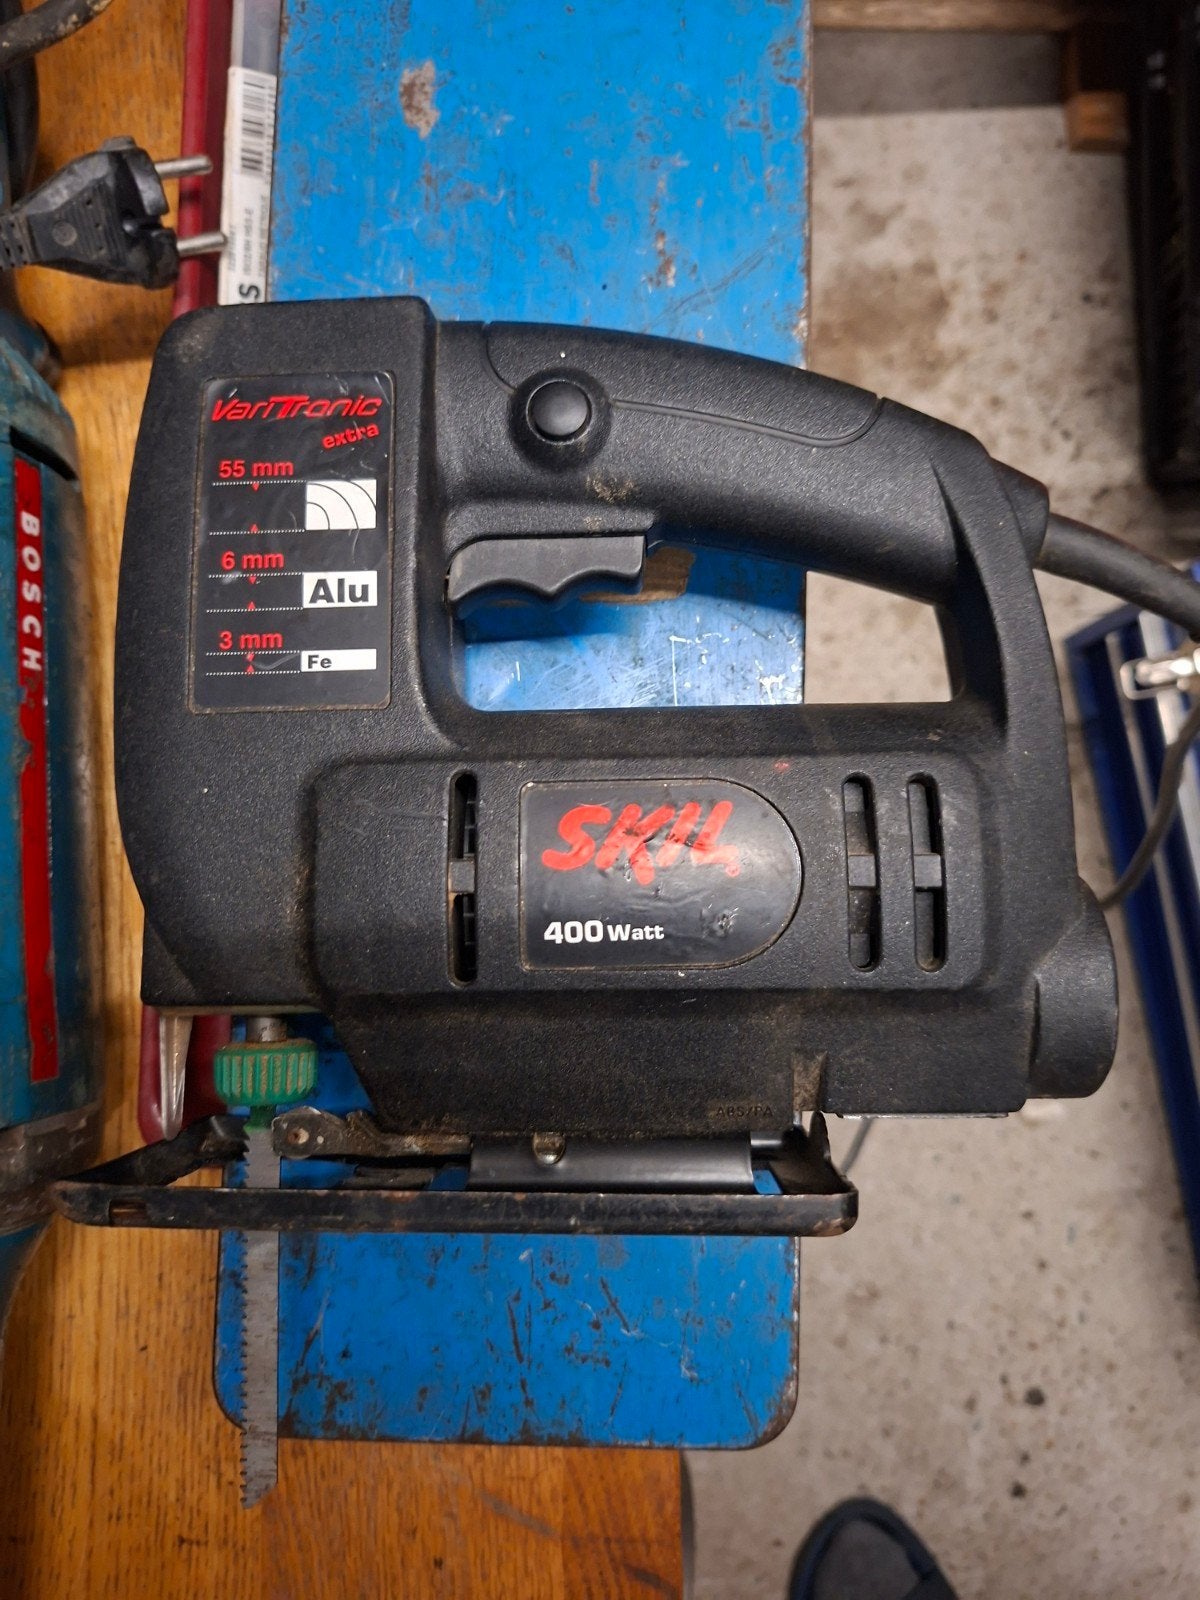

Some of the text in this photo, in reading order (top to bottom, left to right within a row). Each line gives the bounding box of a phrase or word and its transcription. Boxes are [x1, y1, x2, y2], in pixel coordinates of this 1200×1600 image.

[211, 394, 383, 422] VariTronic
[322, 422, 380, 449] extra
[218, 460, 294, 478] 55 mm
[221, 551, 284, 570] 6 mm
[20, 510, 42, 671] BOSCH
[308, 577, 370, 604] Alu
[219, 630, 283, 650] 3 mm
[307, 654, 333, 669] Fe
[541, 800, 739, 886] SKIL
[543, 920, 665, 944] 400 Watt
